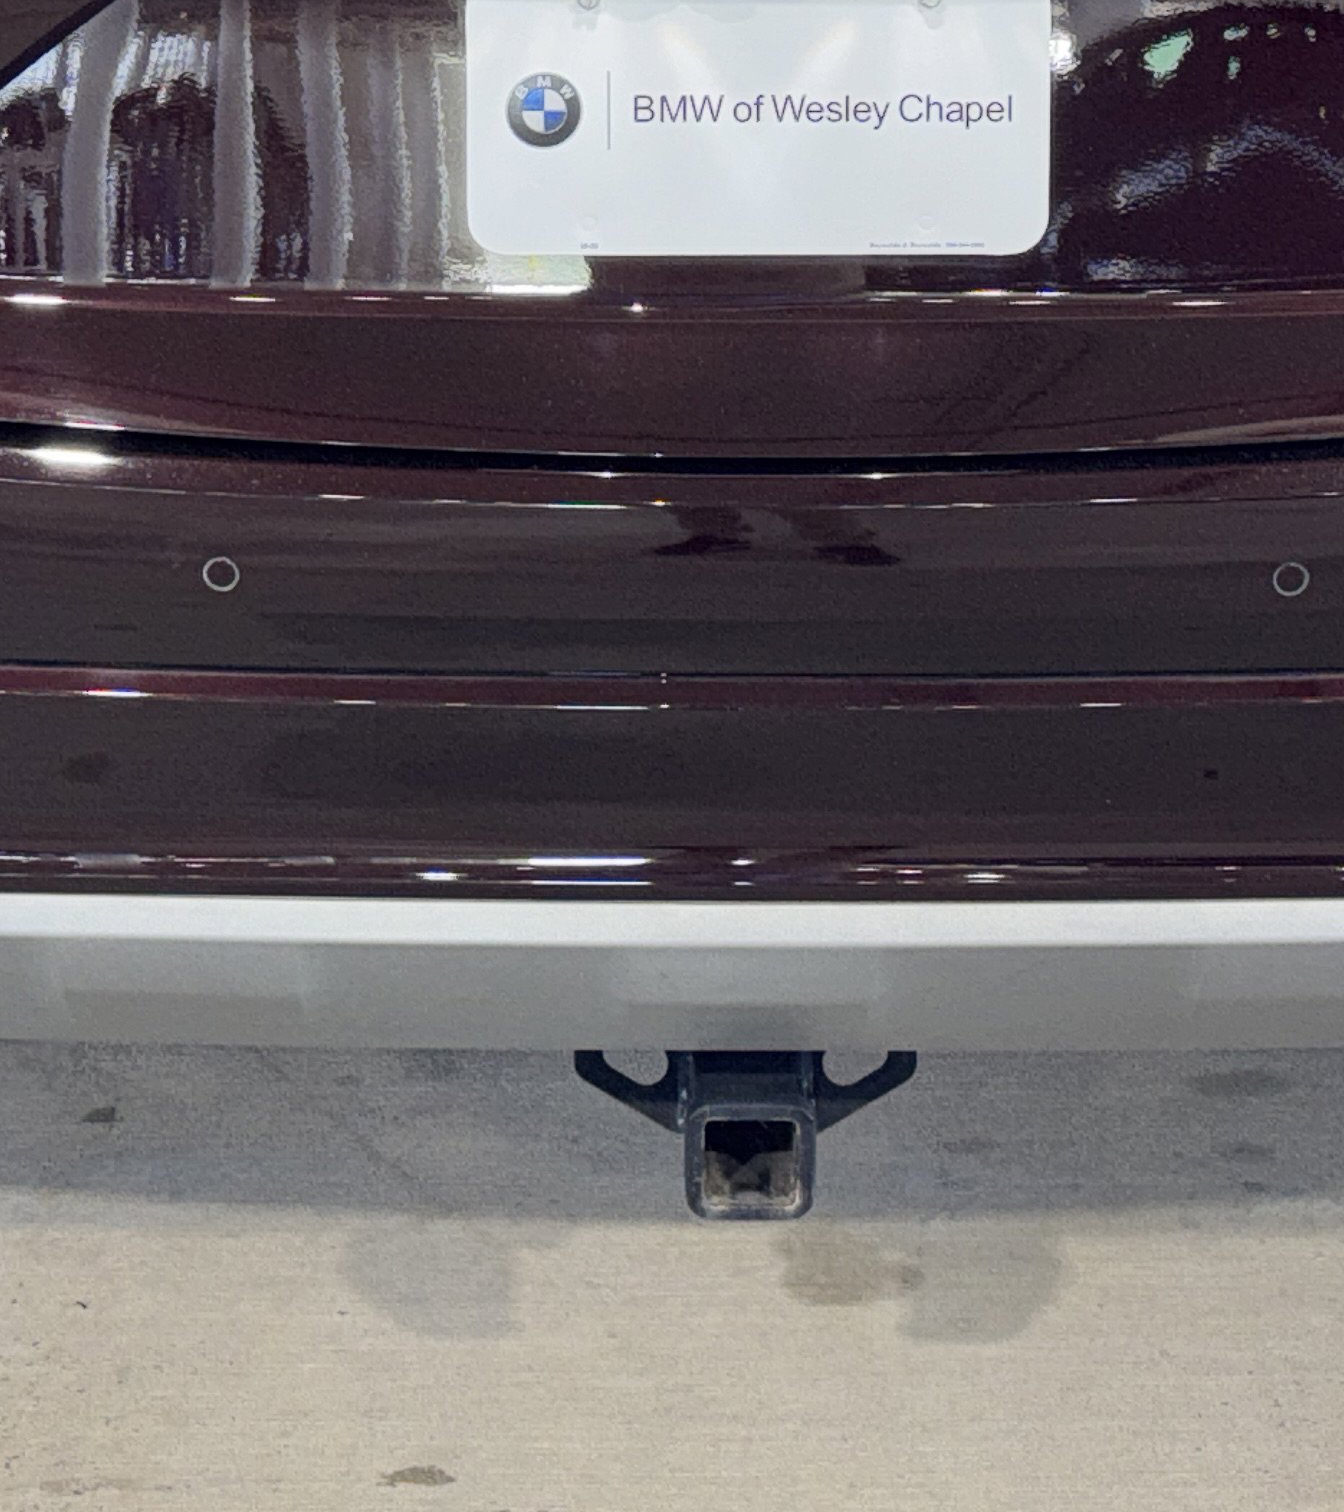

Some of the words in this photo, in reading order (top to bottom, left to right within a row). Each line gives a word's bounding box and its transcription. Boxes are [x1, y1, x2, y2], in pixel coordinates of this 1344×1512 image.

[515, 74, 575, 101] BMW
[632, 94, 725, 123] BMW
[732, 94, 764, 123] of
[771, 94, 890, 130] Wesley
[898, 93, 1013, 129] Chapel
